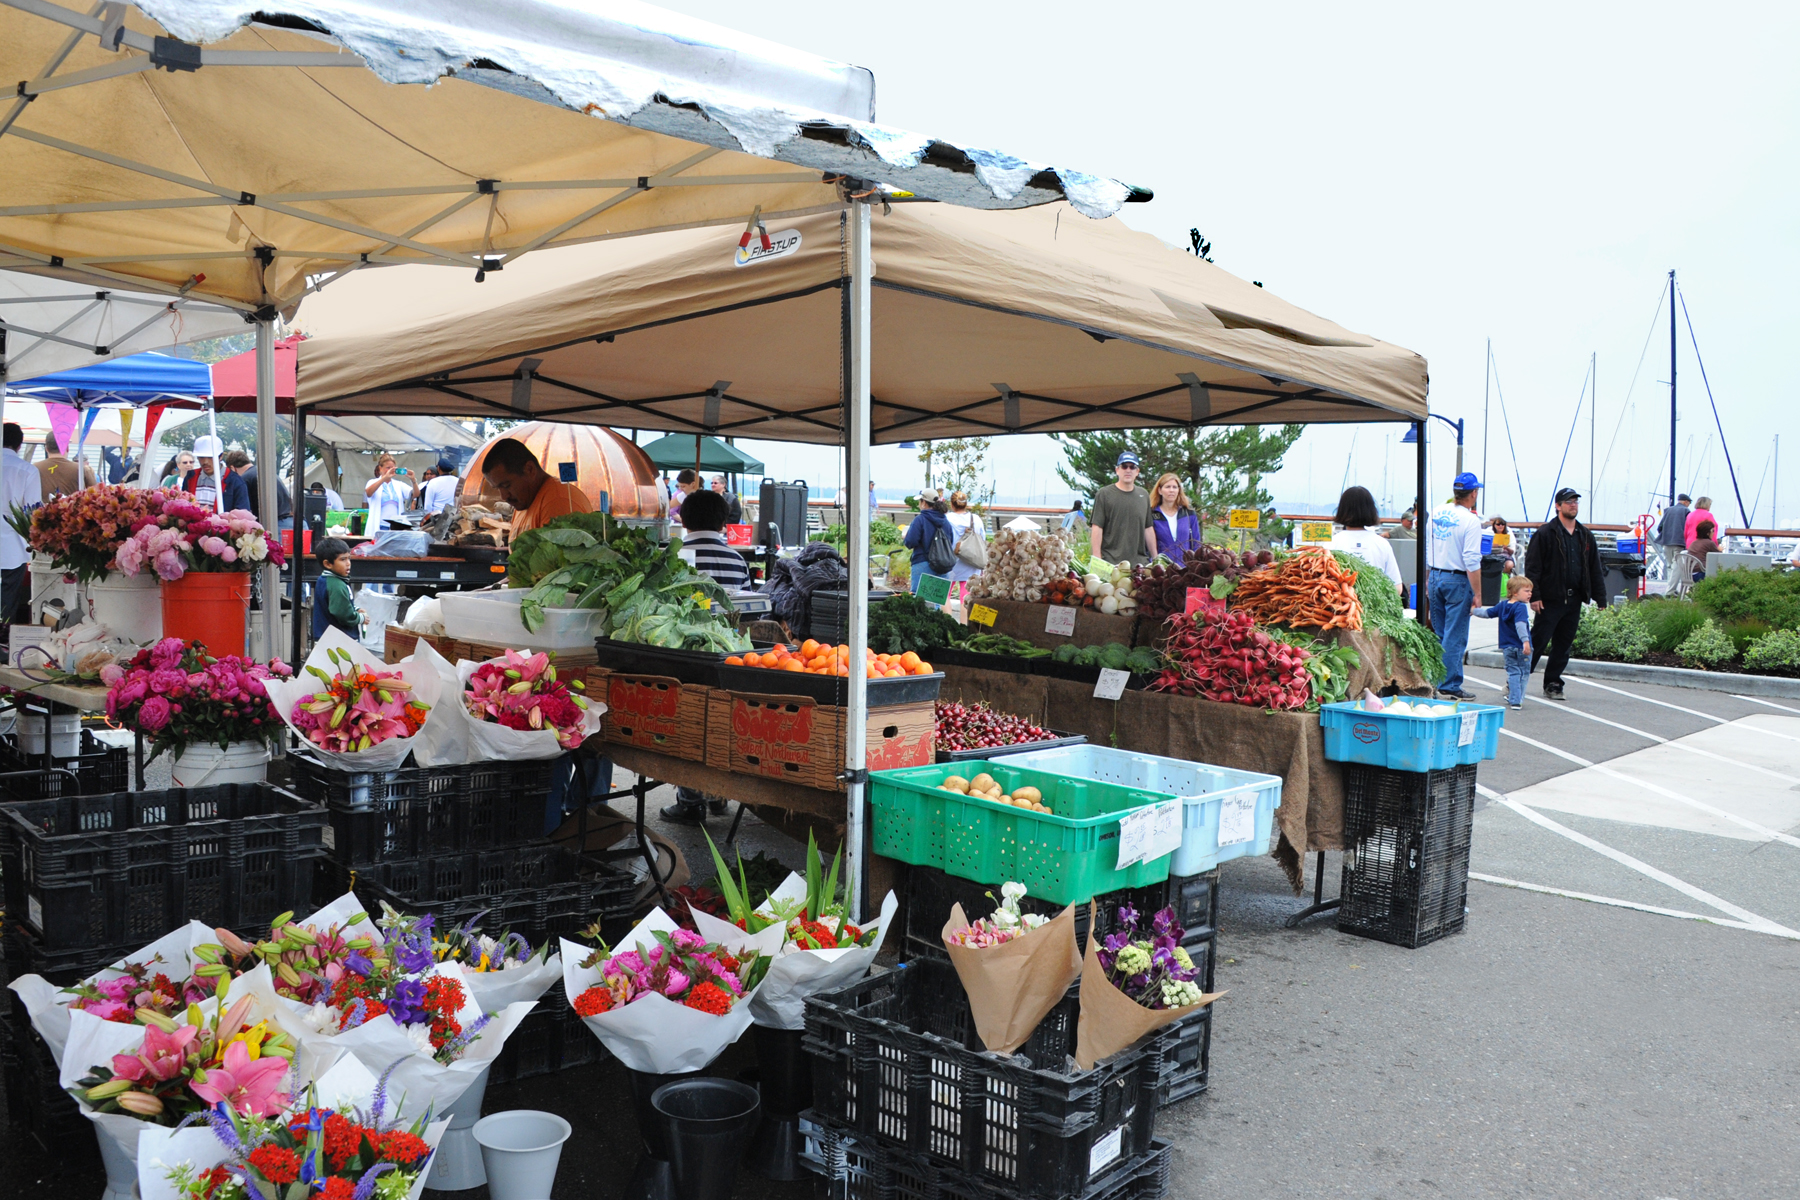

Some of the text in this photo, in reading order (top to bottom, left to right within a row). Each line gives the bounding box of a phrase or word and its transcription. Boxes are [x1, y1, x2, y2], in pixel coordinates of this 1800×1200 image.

[612, 711, 676, 736] Select Northwest
[632, 729, 653, 748] Fruit
[736, 737, 811, 764] Select Northwest
[760, 759, 783, 777] Fruit
